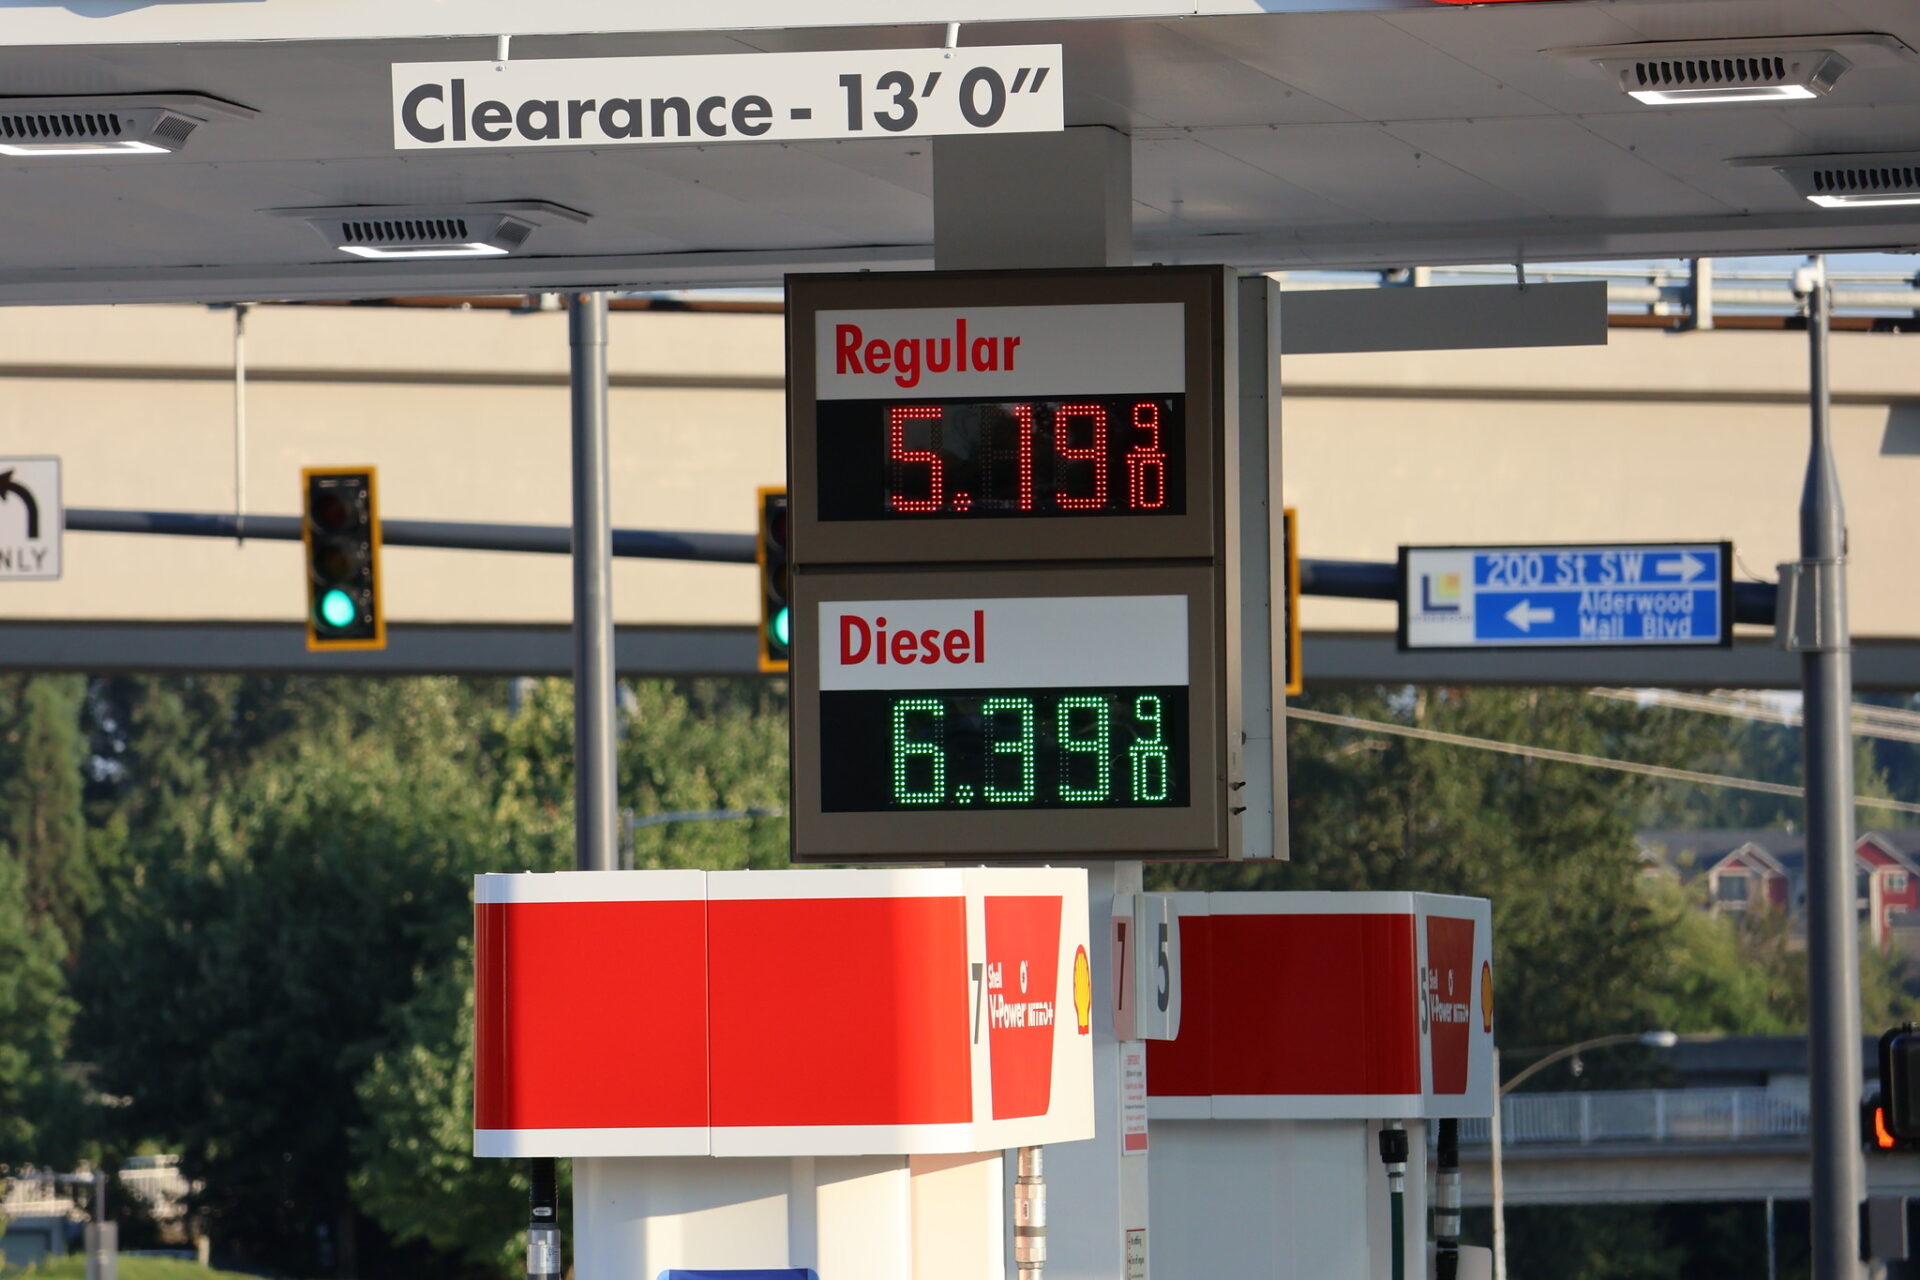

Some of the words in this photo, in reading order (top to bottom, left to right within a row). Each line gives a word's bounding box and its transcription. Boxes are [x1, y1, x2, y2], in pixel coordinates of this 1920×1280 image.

[401, 78, 773, 143] Clearance
[790, 108, 812, 120] -
[836, 318, 1021, 388] Regular
[890, 403, 1107, 512] 5.19
[0, 547, 48, 572] NLY
[1486, 553, 1544, 586] 200
[1555, 552, 1587, 586] St
[1600, 551, 1645, 586] SW
[1578, 589, 1695, 616] Alderwood
[1580, 615, 1625, 641] Mall
[1642, 613, 1693, 641] Blvd
[839, 610, 985, 666] Diesel
[893, 697, 1110, 805] 6.39
[988, 961, 1002, 989] Shell
[1117, 923, 1126, 1011] 7
[1157, 923, 1170, 1012] 5
[971, 962, 984, 1045] 7
[989, 993, 1026, 1029] V-Power
[1421, 968, 1428, 1034] 5
